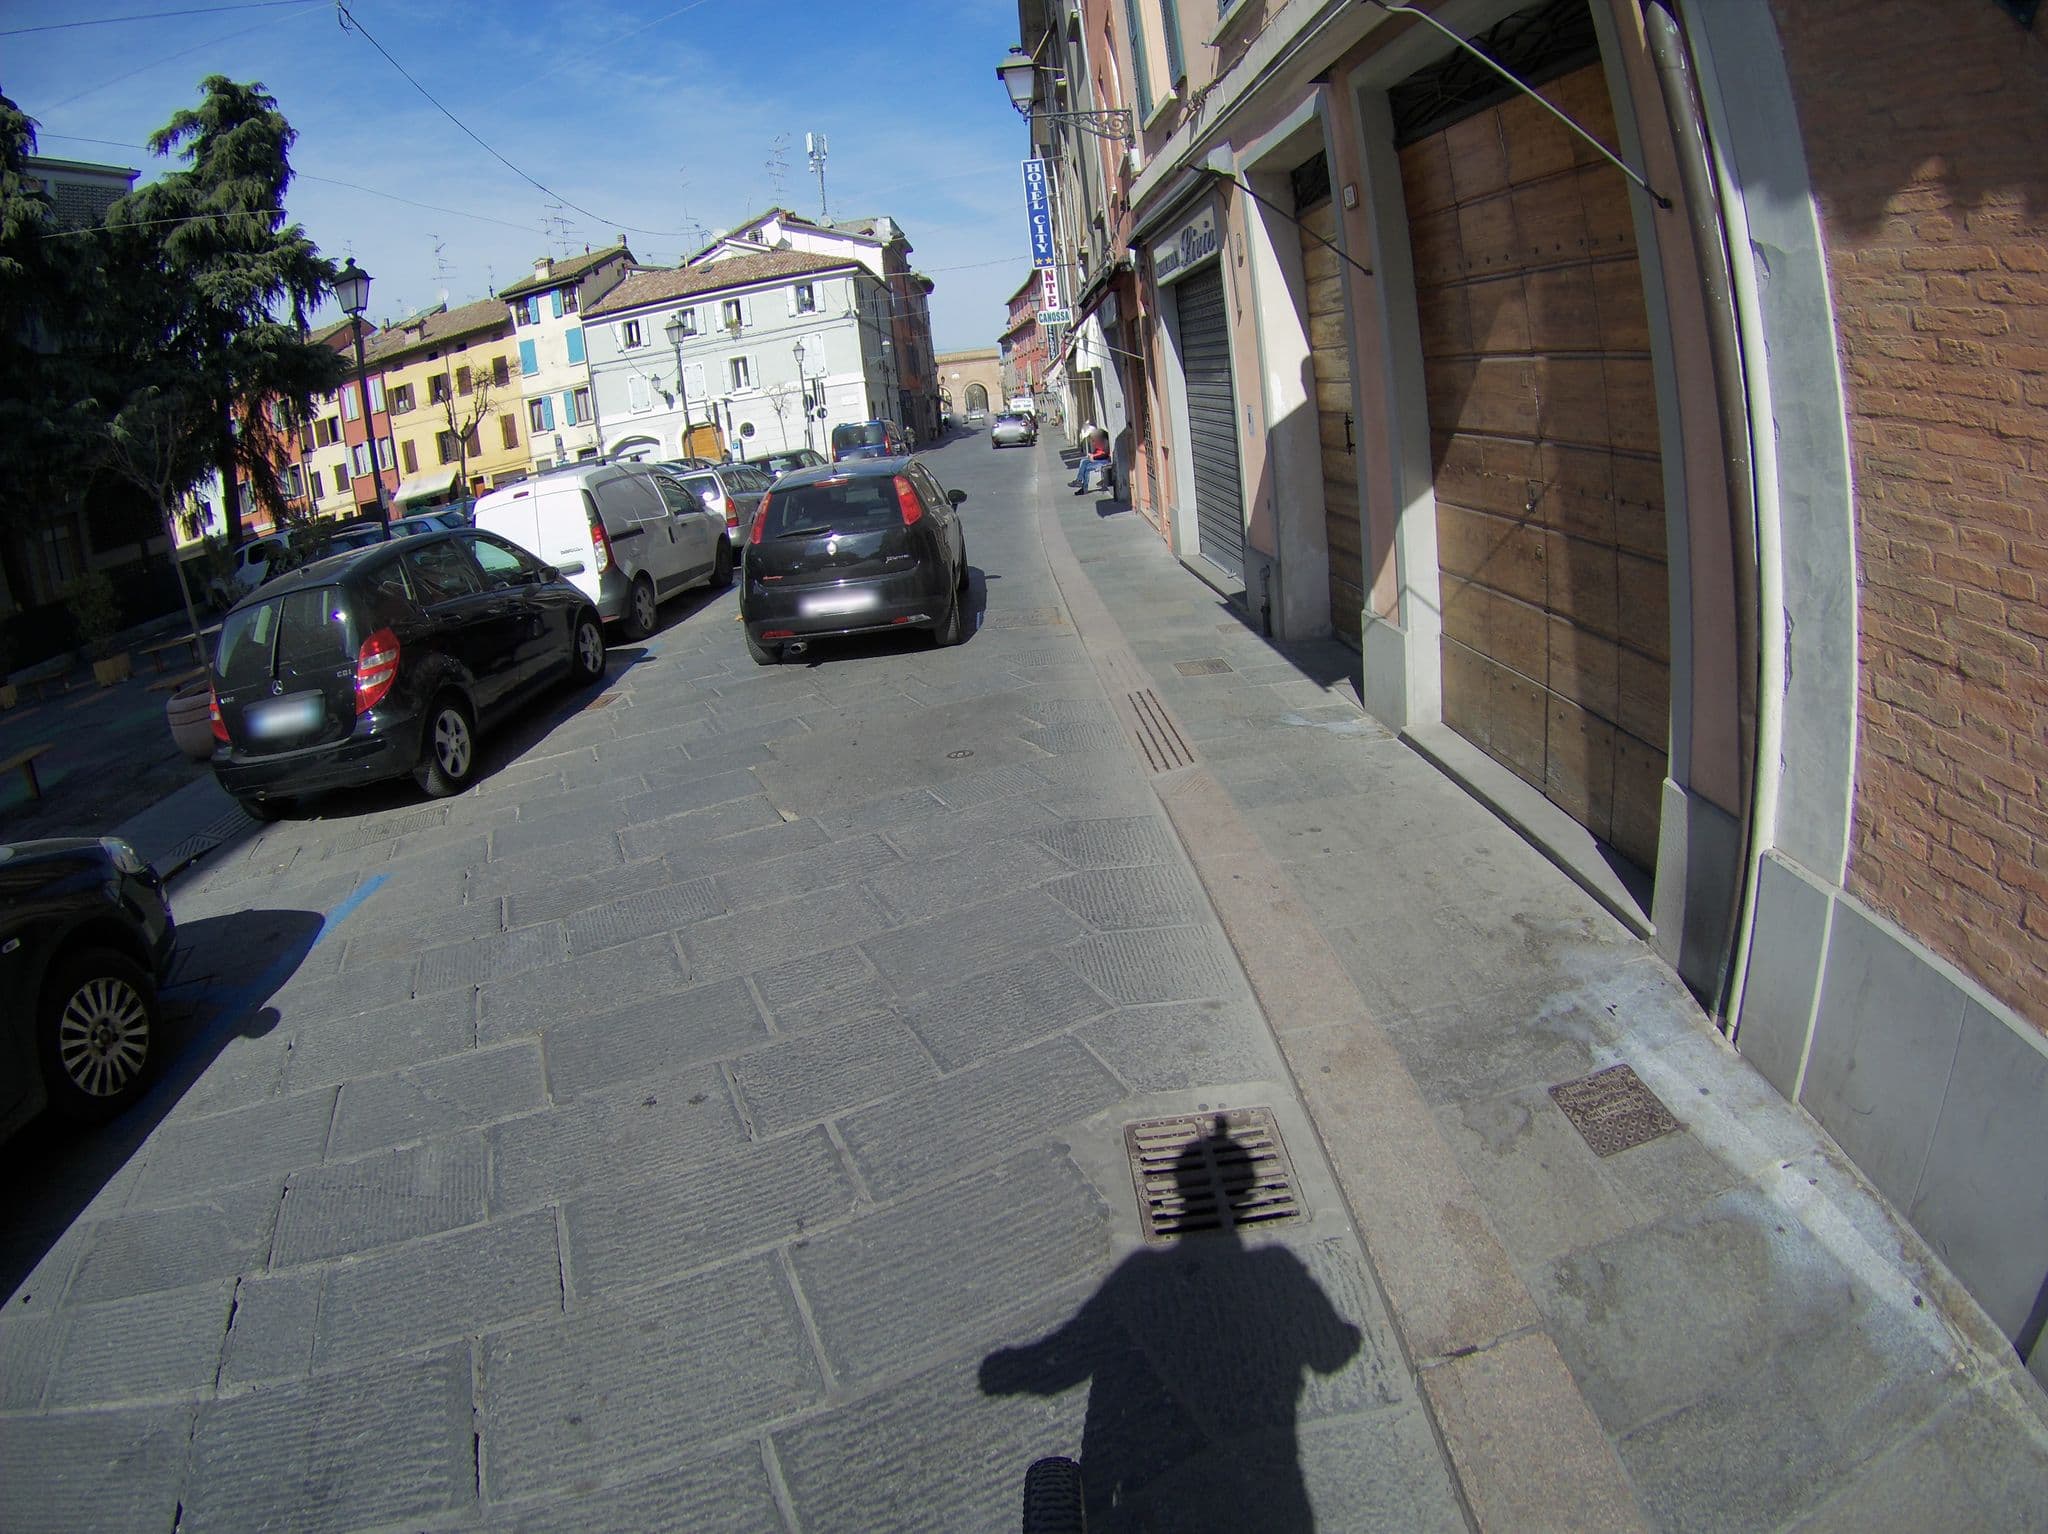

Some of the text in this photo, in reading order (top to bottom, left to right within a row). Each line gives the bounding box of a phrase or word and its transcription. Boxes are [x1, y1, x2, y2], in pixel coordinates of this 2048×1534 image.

[1025, 163, 1049, 254] HOTEL CITY
[1038, 311, 1069, 324] CANOSSA
